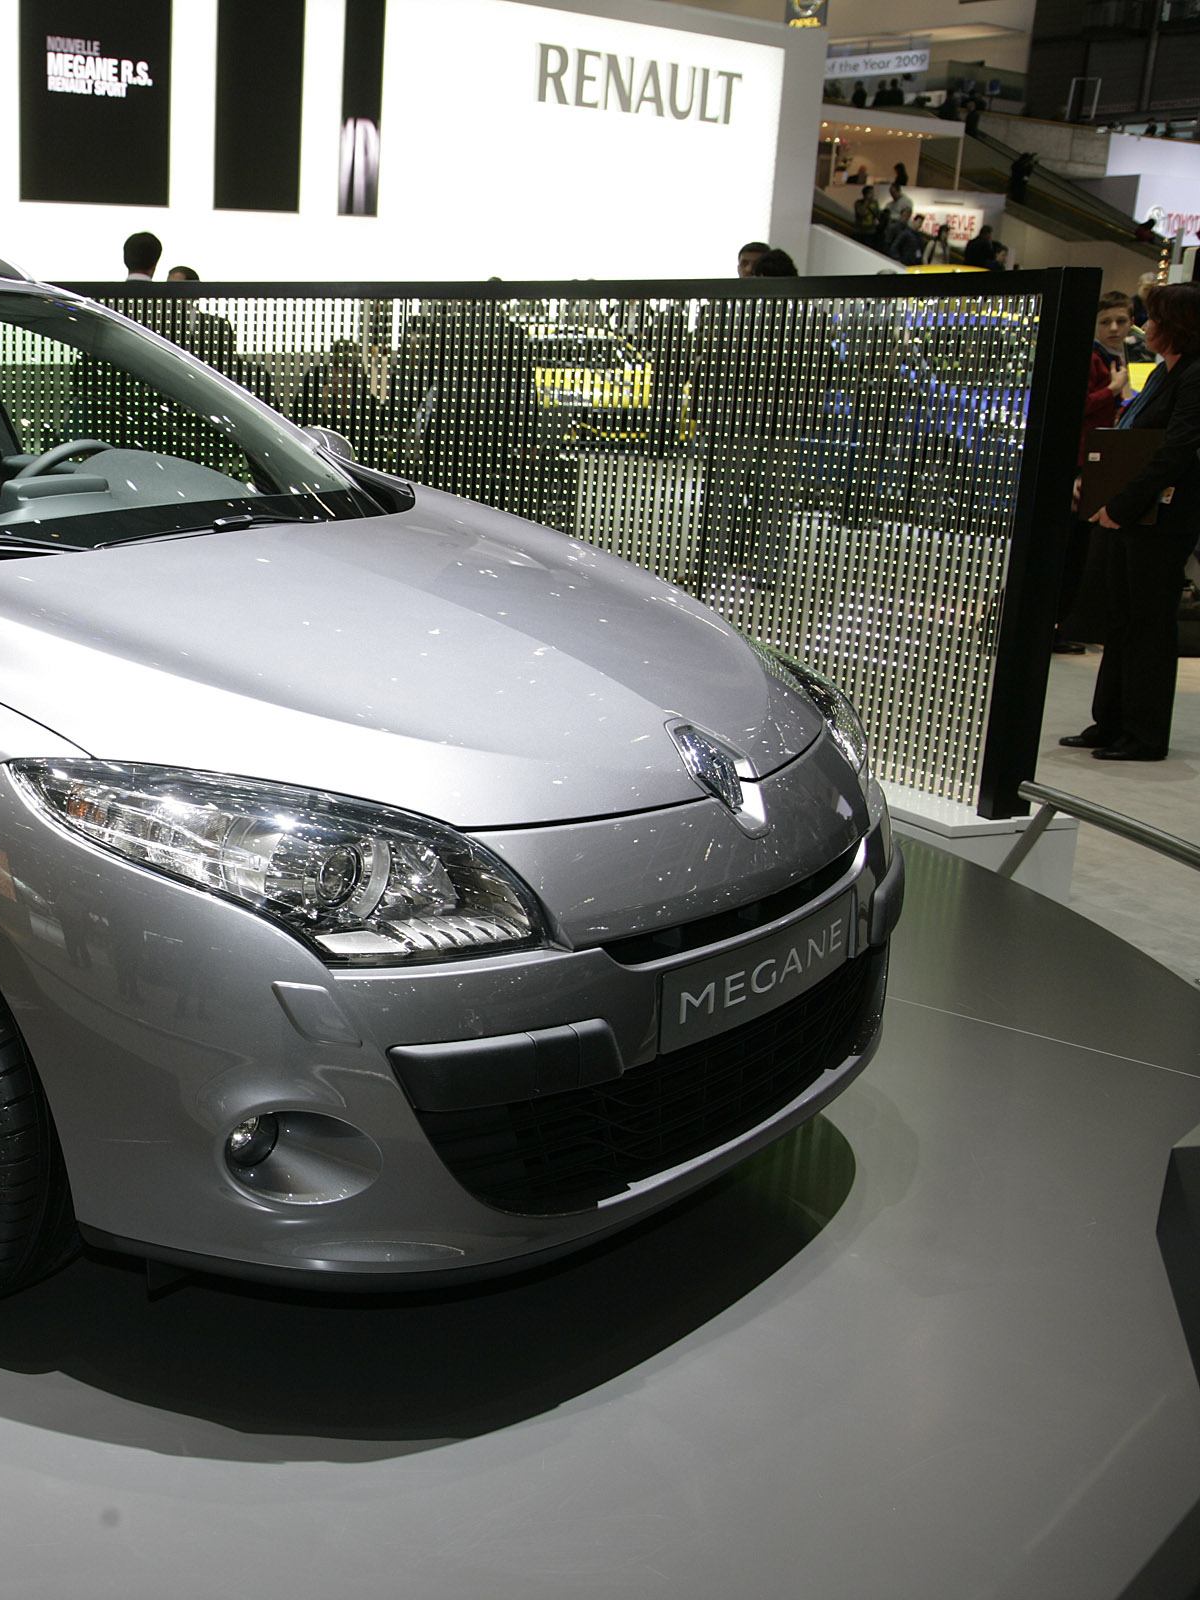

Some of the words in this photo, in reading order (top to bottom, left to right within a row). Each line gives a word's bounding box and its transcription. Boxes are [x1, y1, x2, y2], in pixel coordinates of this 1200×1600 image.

[46, 36, 100, 56] NOUVELLE
[840, 61, 860, 72] the
[863, 58, 891, 71] Year
[895, 54, 927, 68] 2009
[47, 51, 118, 82] MEGANE
[121, 60, 153, 86] R.S.
[536, 42, 743, 125] RENAULT
[679, 918, 842, 1025] MEGANE
